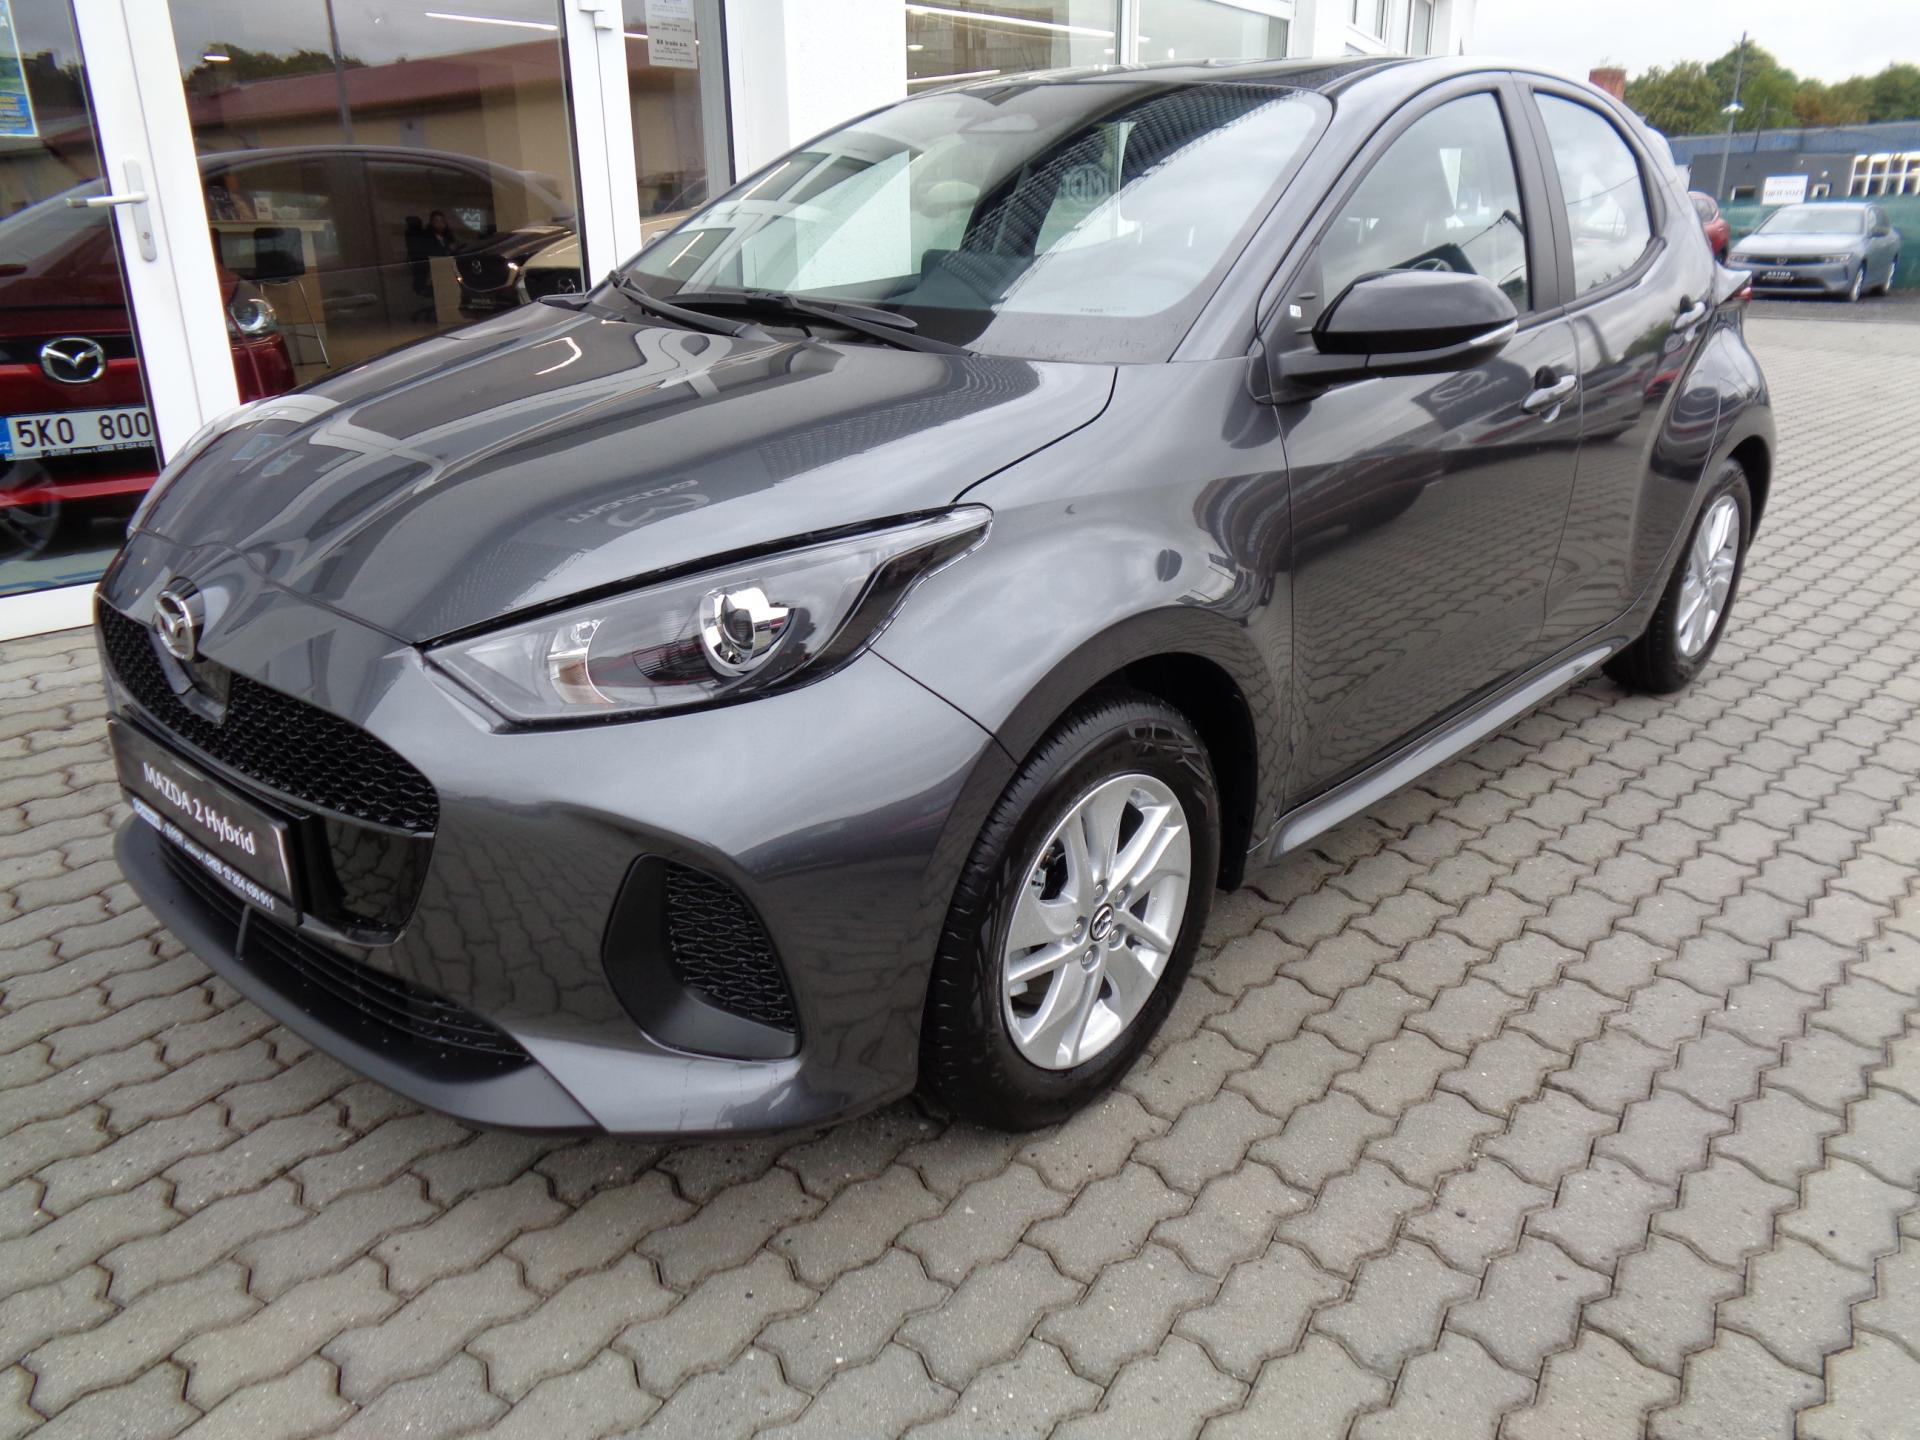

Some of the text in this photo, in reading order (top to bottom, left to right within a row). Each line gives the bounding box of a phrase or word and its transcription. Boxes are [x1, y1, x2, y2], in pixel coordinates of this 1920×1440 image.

[143, 761, 192, 815] MAZDA
[192, 798, 204, 823] 2
[204, 806, 256, 856] Hybrid
